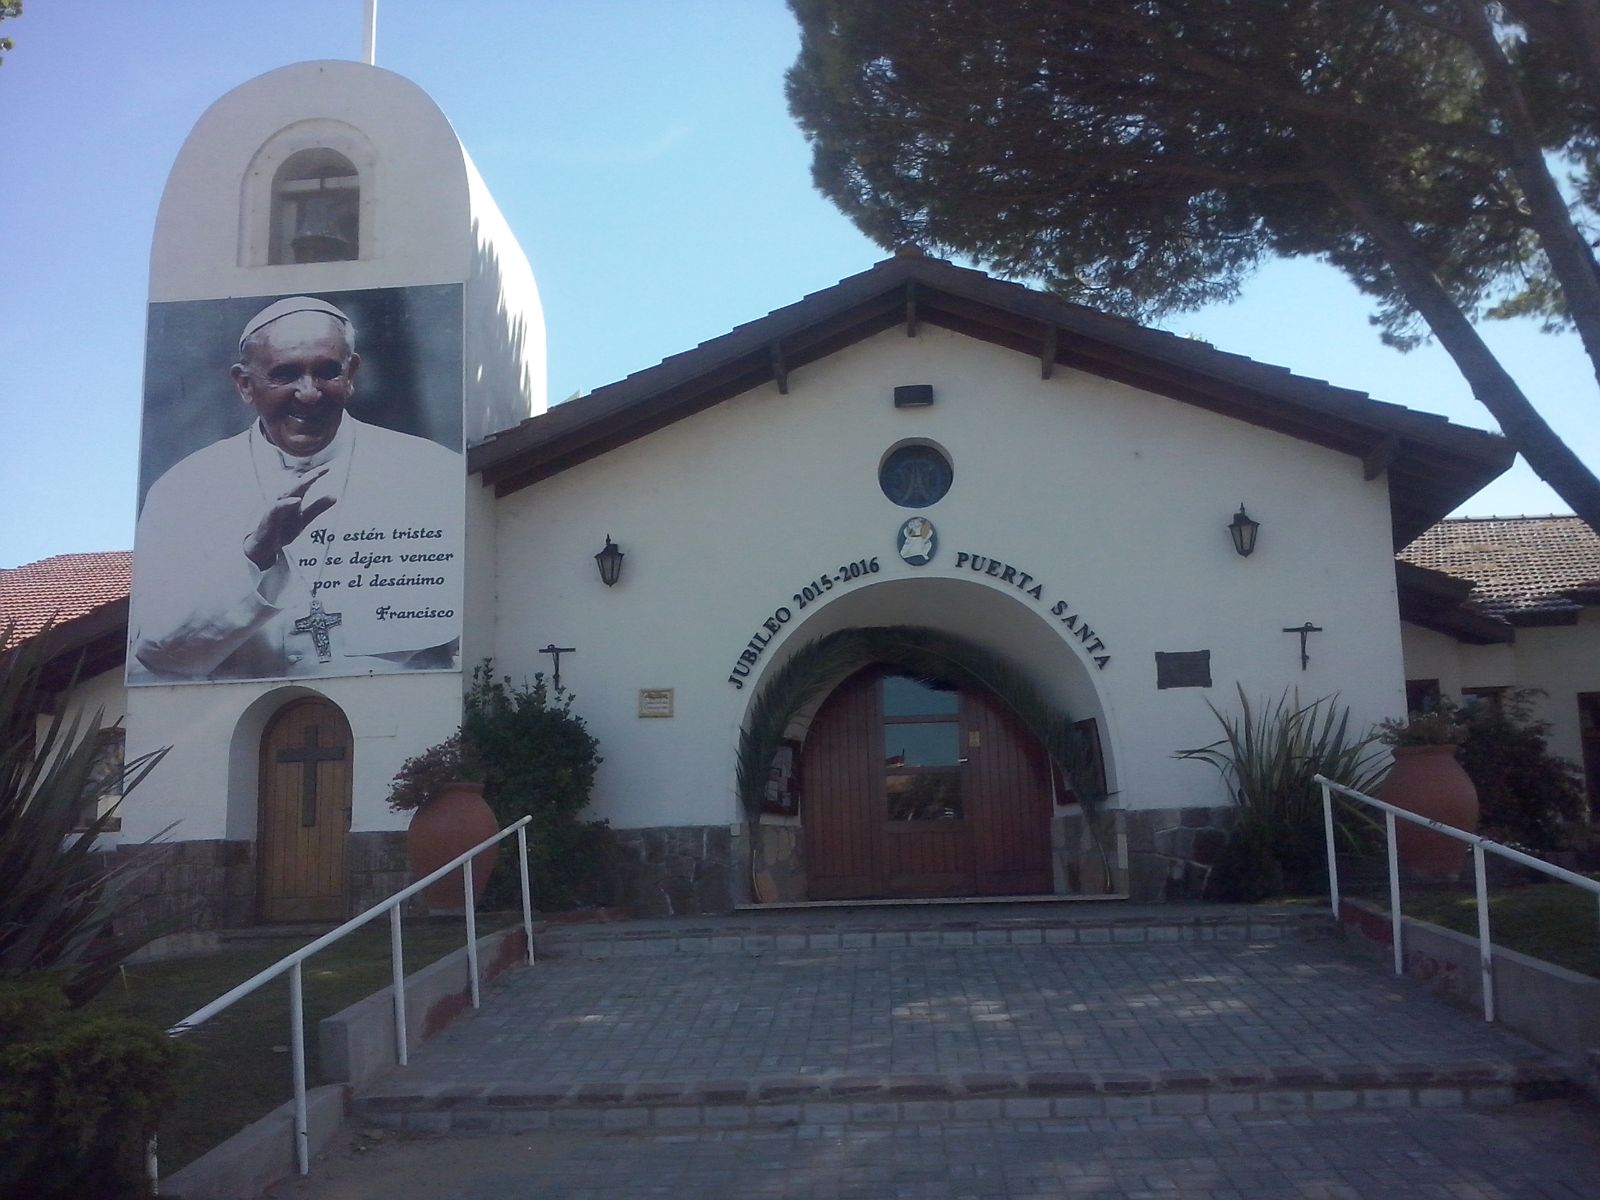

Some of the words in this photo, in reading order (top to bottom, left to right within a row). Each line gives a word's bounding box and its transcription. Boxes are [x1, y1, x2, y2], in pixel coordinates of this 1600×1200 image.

[311, 529, 335, 544] No
[343, 528, 385, 541] estén
[392, 527, 443, 539] tristes
[299, 557, 317, 567] no
[325, 556, 343, 565] se
[350, 552, 393, 568] dejen
[400, 552, 454, 562] vencer
[313, 579, 341, 595] por
[348, 575, 363, 588] el
[369, 574, 445, 587] desánimo
[376, 605, 454, 621] Francisco
[955, 552, 1043, 600] PUERTA
[1051, 600, 1111, 670] SANTA
[728, 606, 791, 689] JUBILEO
[793, 557, 880, 609] 2015-2016
